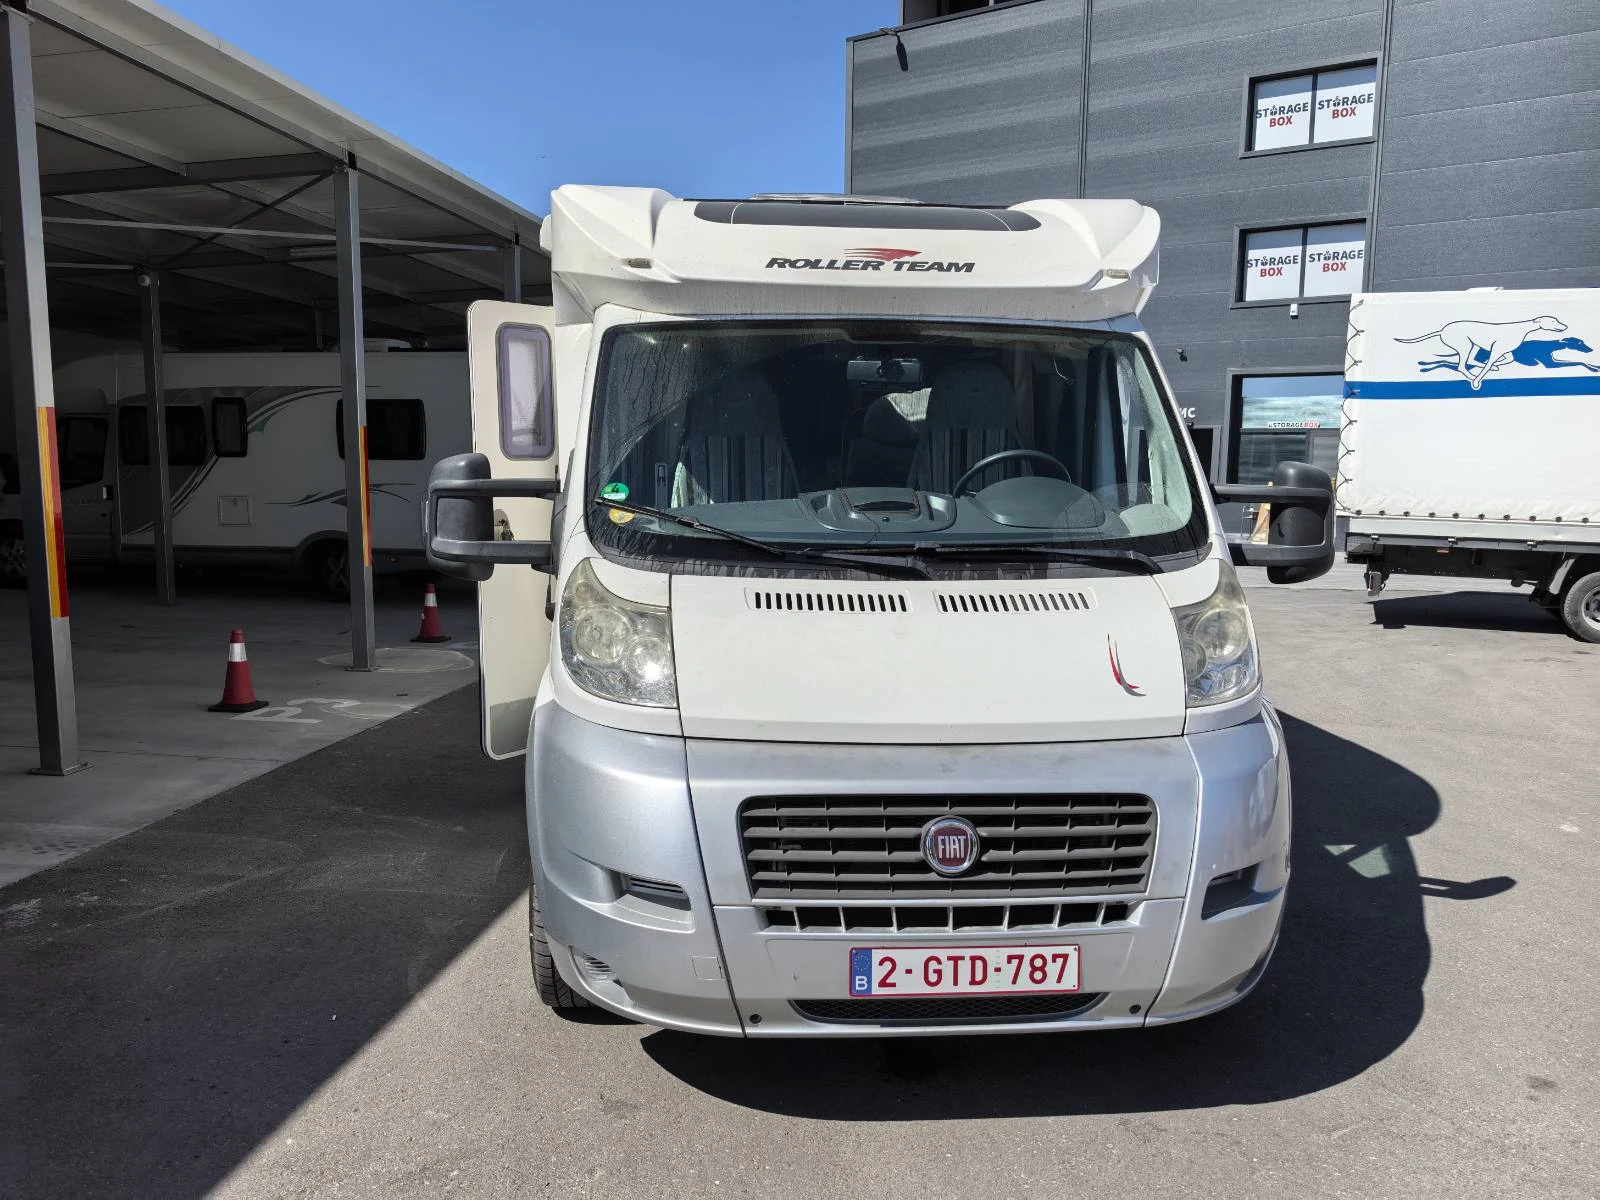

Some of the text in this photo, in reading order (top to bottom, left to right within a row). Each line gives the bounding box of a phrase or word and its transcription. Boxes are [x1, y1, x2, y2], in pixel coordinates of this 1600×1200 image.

[1317, 93, 1374, 110] STORAGE
[1255, 102, 1309, 119] STORAGE
[1332, 106, 1357, 119] BOX
[1269, 115, 1293, 128] BOX
[1246, 254, 1299, 268] STORAGE
[1308, 249, 1364, 263] STORAGE
[765, 257, 976, 273] ROLLER TEAM
[1322, 262, 1347, 273] BOX
[1259, 267, 1283, 278] BOX
[611, 483, 620, 494] 4
[937, 835, 967, 859] FIAT
[877, 953, 1070, 988] 2-GTD-787
[855, 976, 868, 990] B
